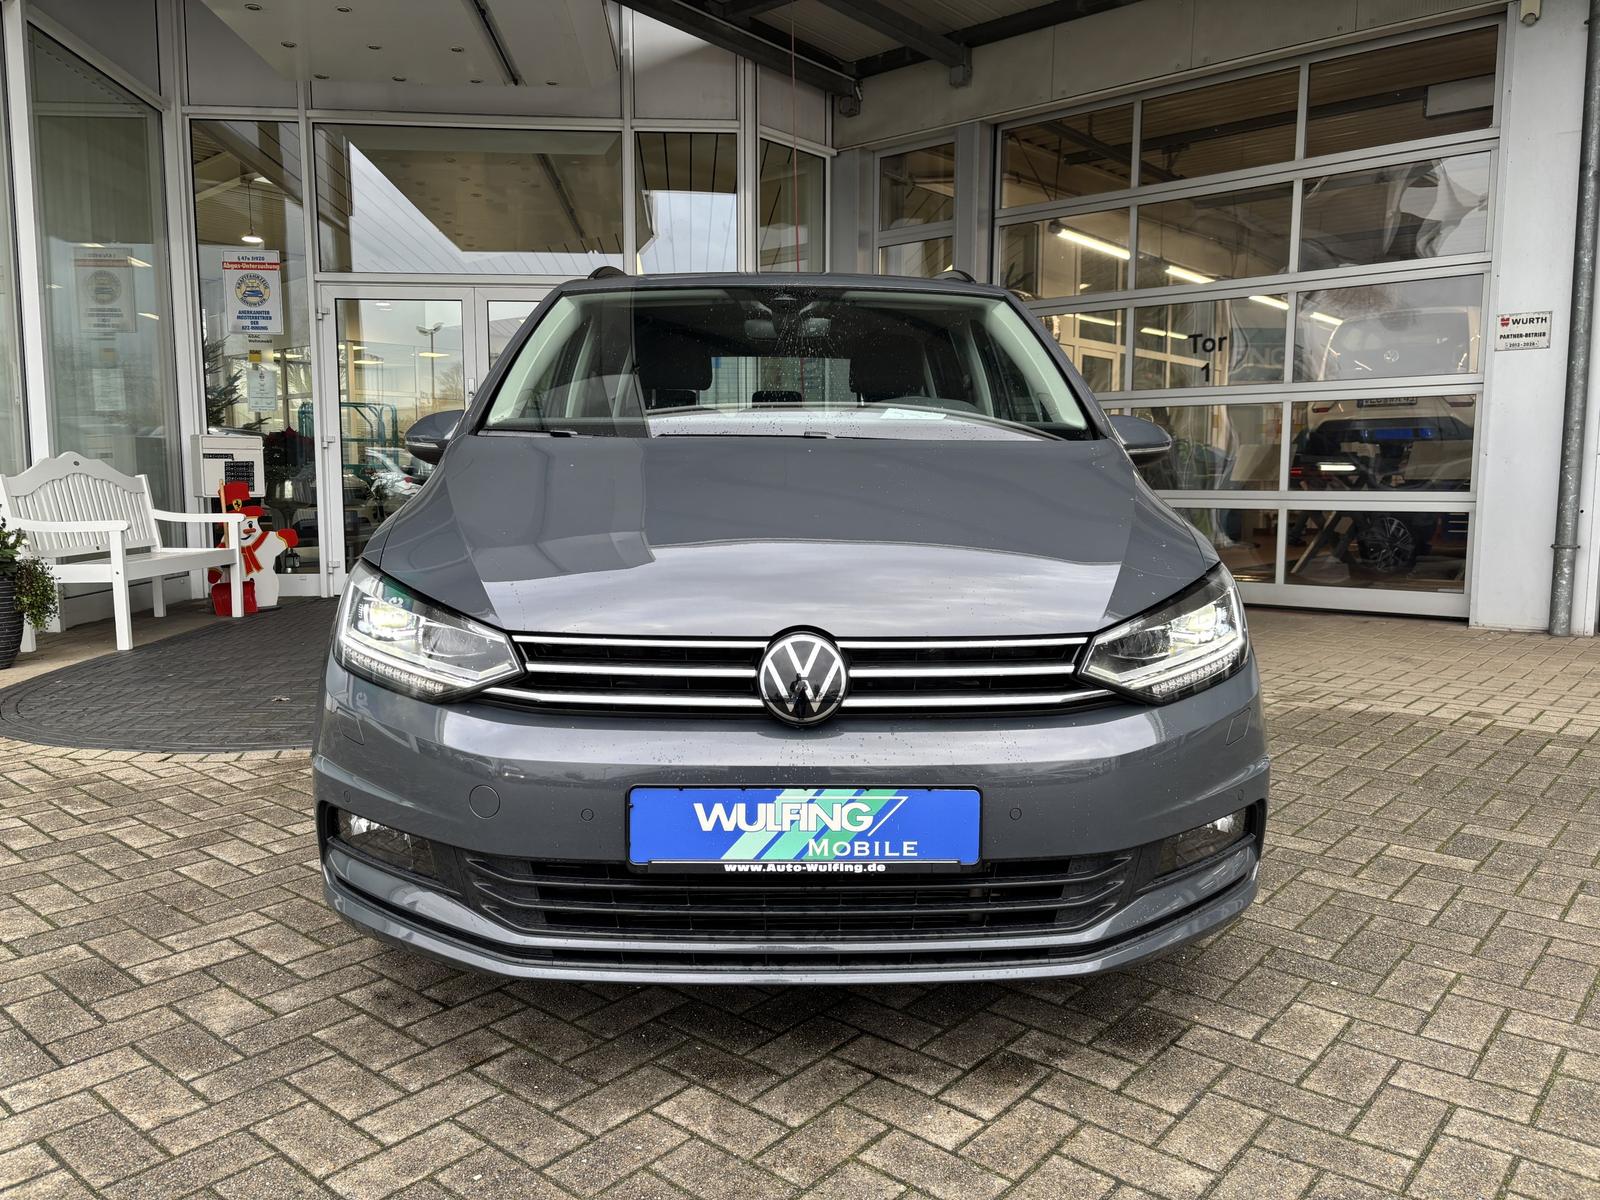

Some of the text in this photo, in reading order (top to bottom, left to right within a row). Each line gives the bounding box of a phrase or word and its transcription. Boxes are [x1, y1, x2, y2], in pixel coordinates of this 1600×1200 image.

[223, 262, 280, 270] Abgas-Untersuchung
[1499, 331, 1547, 340] PARTNER-BETRIEB
[1188, 333, 1228, 354] Tor
[1201, 362, 1210, 382] 1
[807, 838, 919, 858] MOBILE
[723, 863, 887, 874] www.Auto-Wulfing.de
